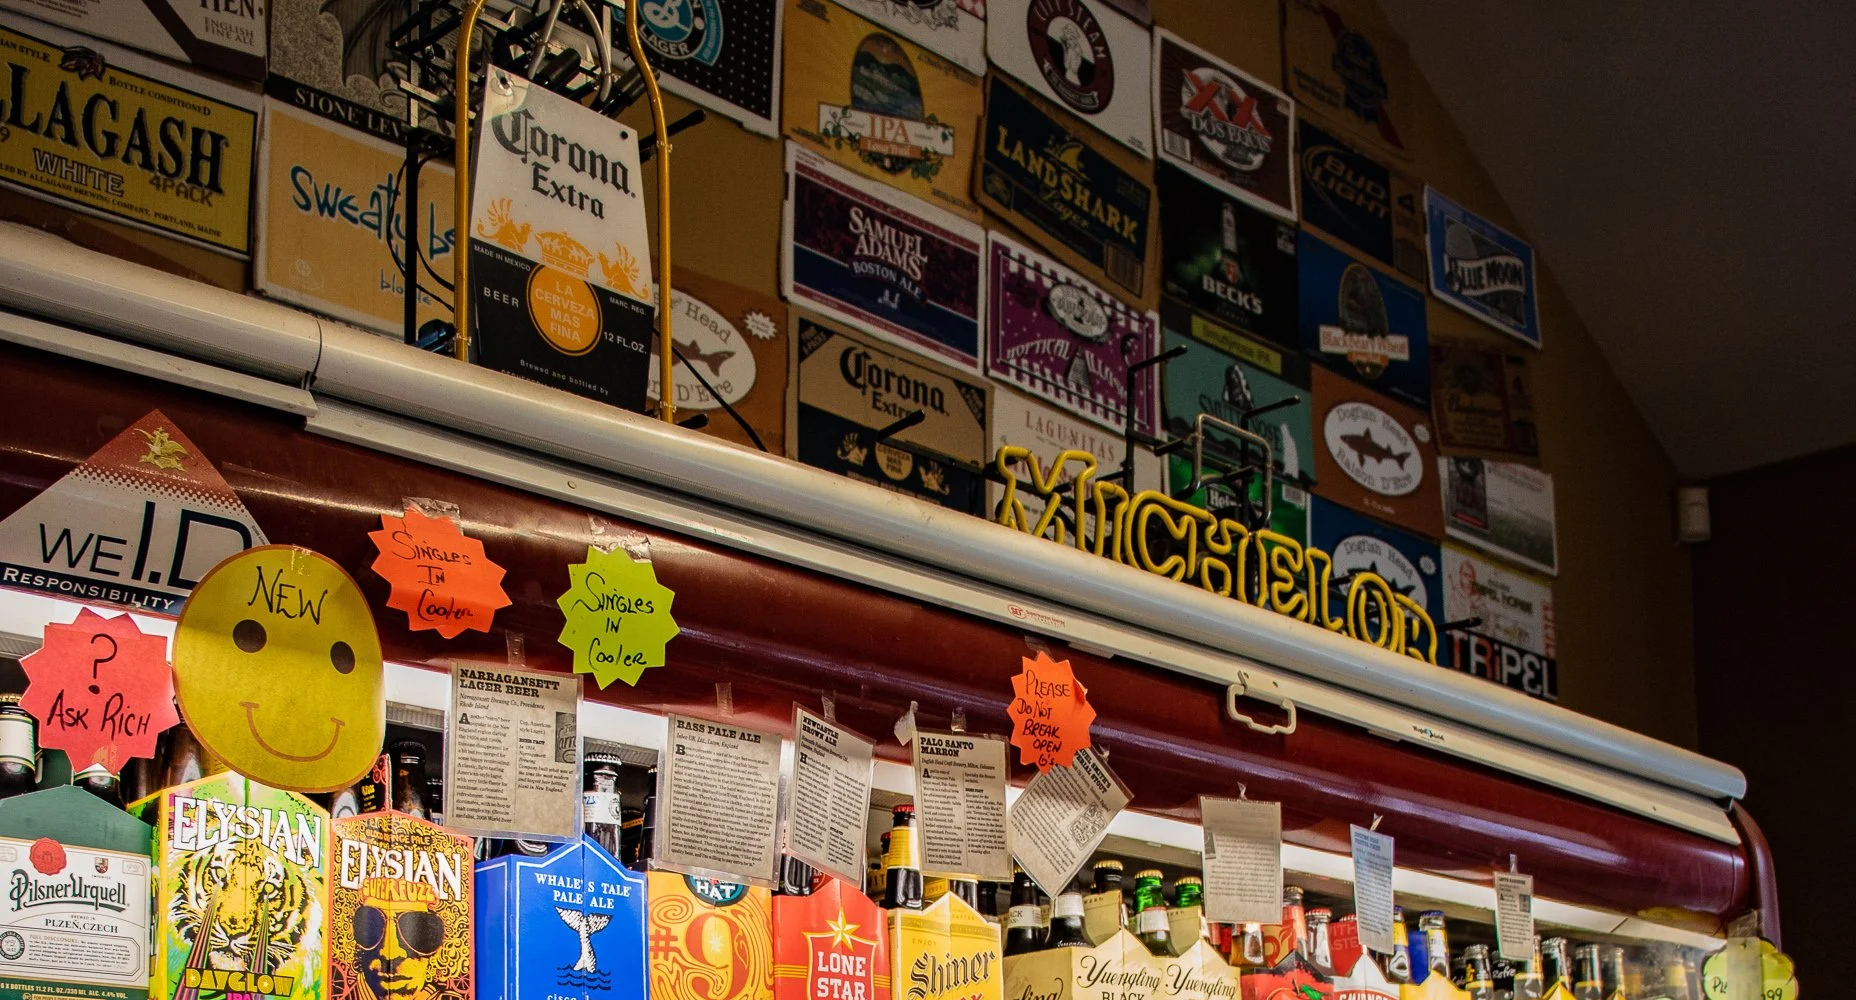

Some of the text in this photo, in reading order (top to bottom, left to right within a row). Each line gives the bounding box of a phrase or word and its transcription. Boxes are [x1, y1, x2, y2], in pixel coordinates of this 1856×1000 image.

[295, 87, 359, 124] STONE
[868, 115, 911, 143] IPA
[492, 109, 631, 196] Corona
[33, 148, 125, 198] WHITE
[149, 173, 214, 208] 4PACK
[532, 161, 605, 220] Extra
[997, 124, 1139, 245] LANDSHARK
[1322, 154, 1388, 202] BUD
[1311, 167, 1391, 221] LIGHT
[849, 206, 928, 263] SAMUEL
[473, 244, 532, 272] MADE IN MEXICO
[854, 235, 922, 282] ADAMS
[1446, 257, 1523, 294] BLUE MOON
[483, 286, 520, 308] BEER
[555, 279, 574, 298] LA
[852, 260, 922, 299] BOSTON ALE
[1202, 273, 1263, 316] BECK'S
[535, 288, 596, 321] CERVEZA
[551, 308, 581, 328] MAS
[550, 323, 582, 343] FINA
[686, 302, 732, 344] Head
[840, 346, 946, 415] Corona
[1025, 409, 1116, 464] LAGUNITAS
[1337, 405, 1409, 446] Dogfish Head
[38, 522, 128, 578] WE
[2, 567, 175, 612] RESPONSIBILITY
[248, 566, 328, 625] NEW
[605, 618, 621, 634] IN
[91, 632, 118, 695] ?
[459, 668, 560, 691] NARRAGANSETT
[459, 678, 540, 698] LAGER BEER
[1025, 669, 1071, 698] PLEASE
[676, 719, 762, 744] BASS PALE ALE
[802, 716, 839, 739] NEWCASTLE
[802, 724, 837, 747] BROWN ALE
[920, 737, 974, 751] PALO SANTO
[1022, 721, 1060, 739] BREAK
[920, 745, 960, 757] MARRON
[1033, 739, 1062, 753] OPEN
[172, 795, 322, 869] ELYSIAN
[340, 838, 462, 901] ELYSIAN
[553, 890, 615, 909] PALE ALE
[602, 882, 630, 897] TALE
[184, 967, 294, 997] DAYGLOW
[817, 950, 867, 978] LONE
[1077, 955, 1161, 993] Yuengling
